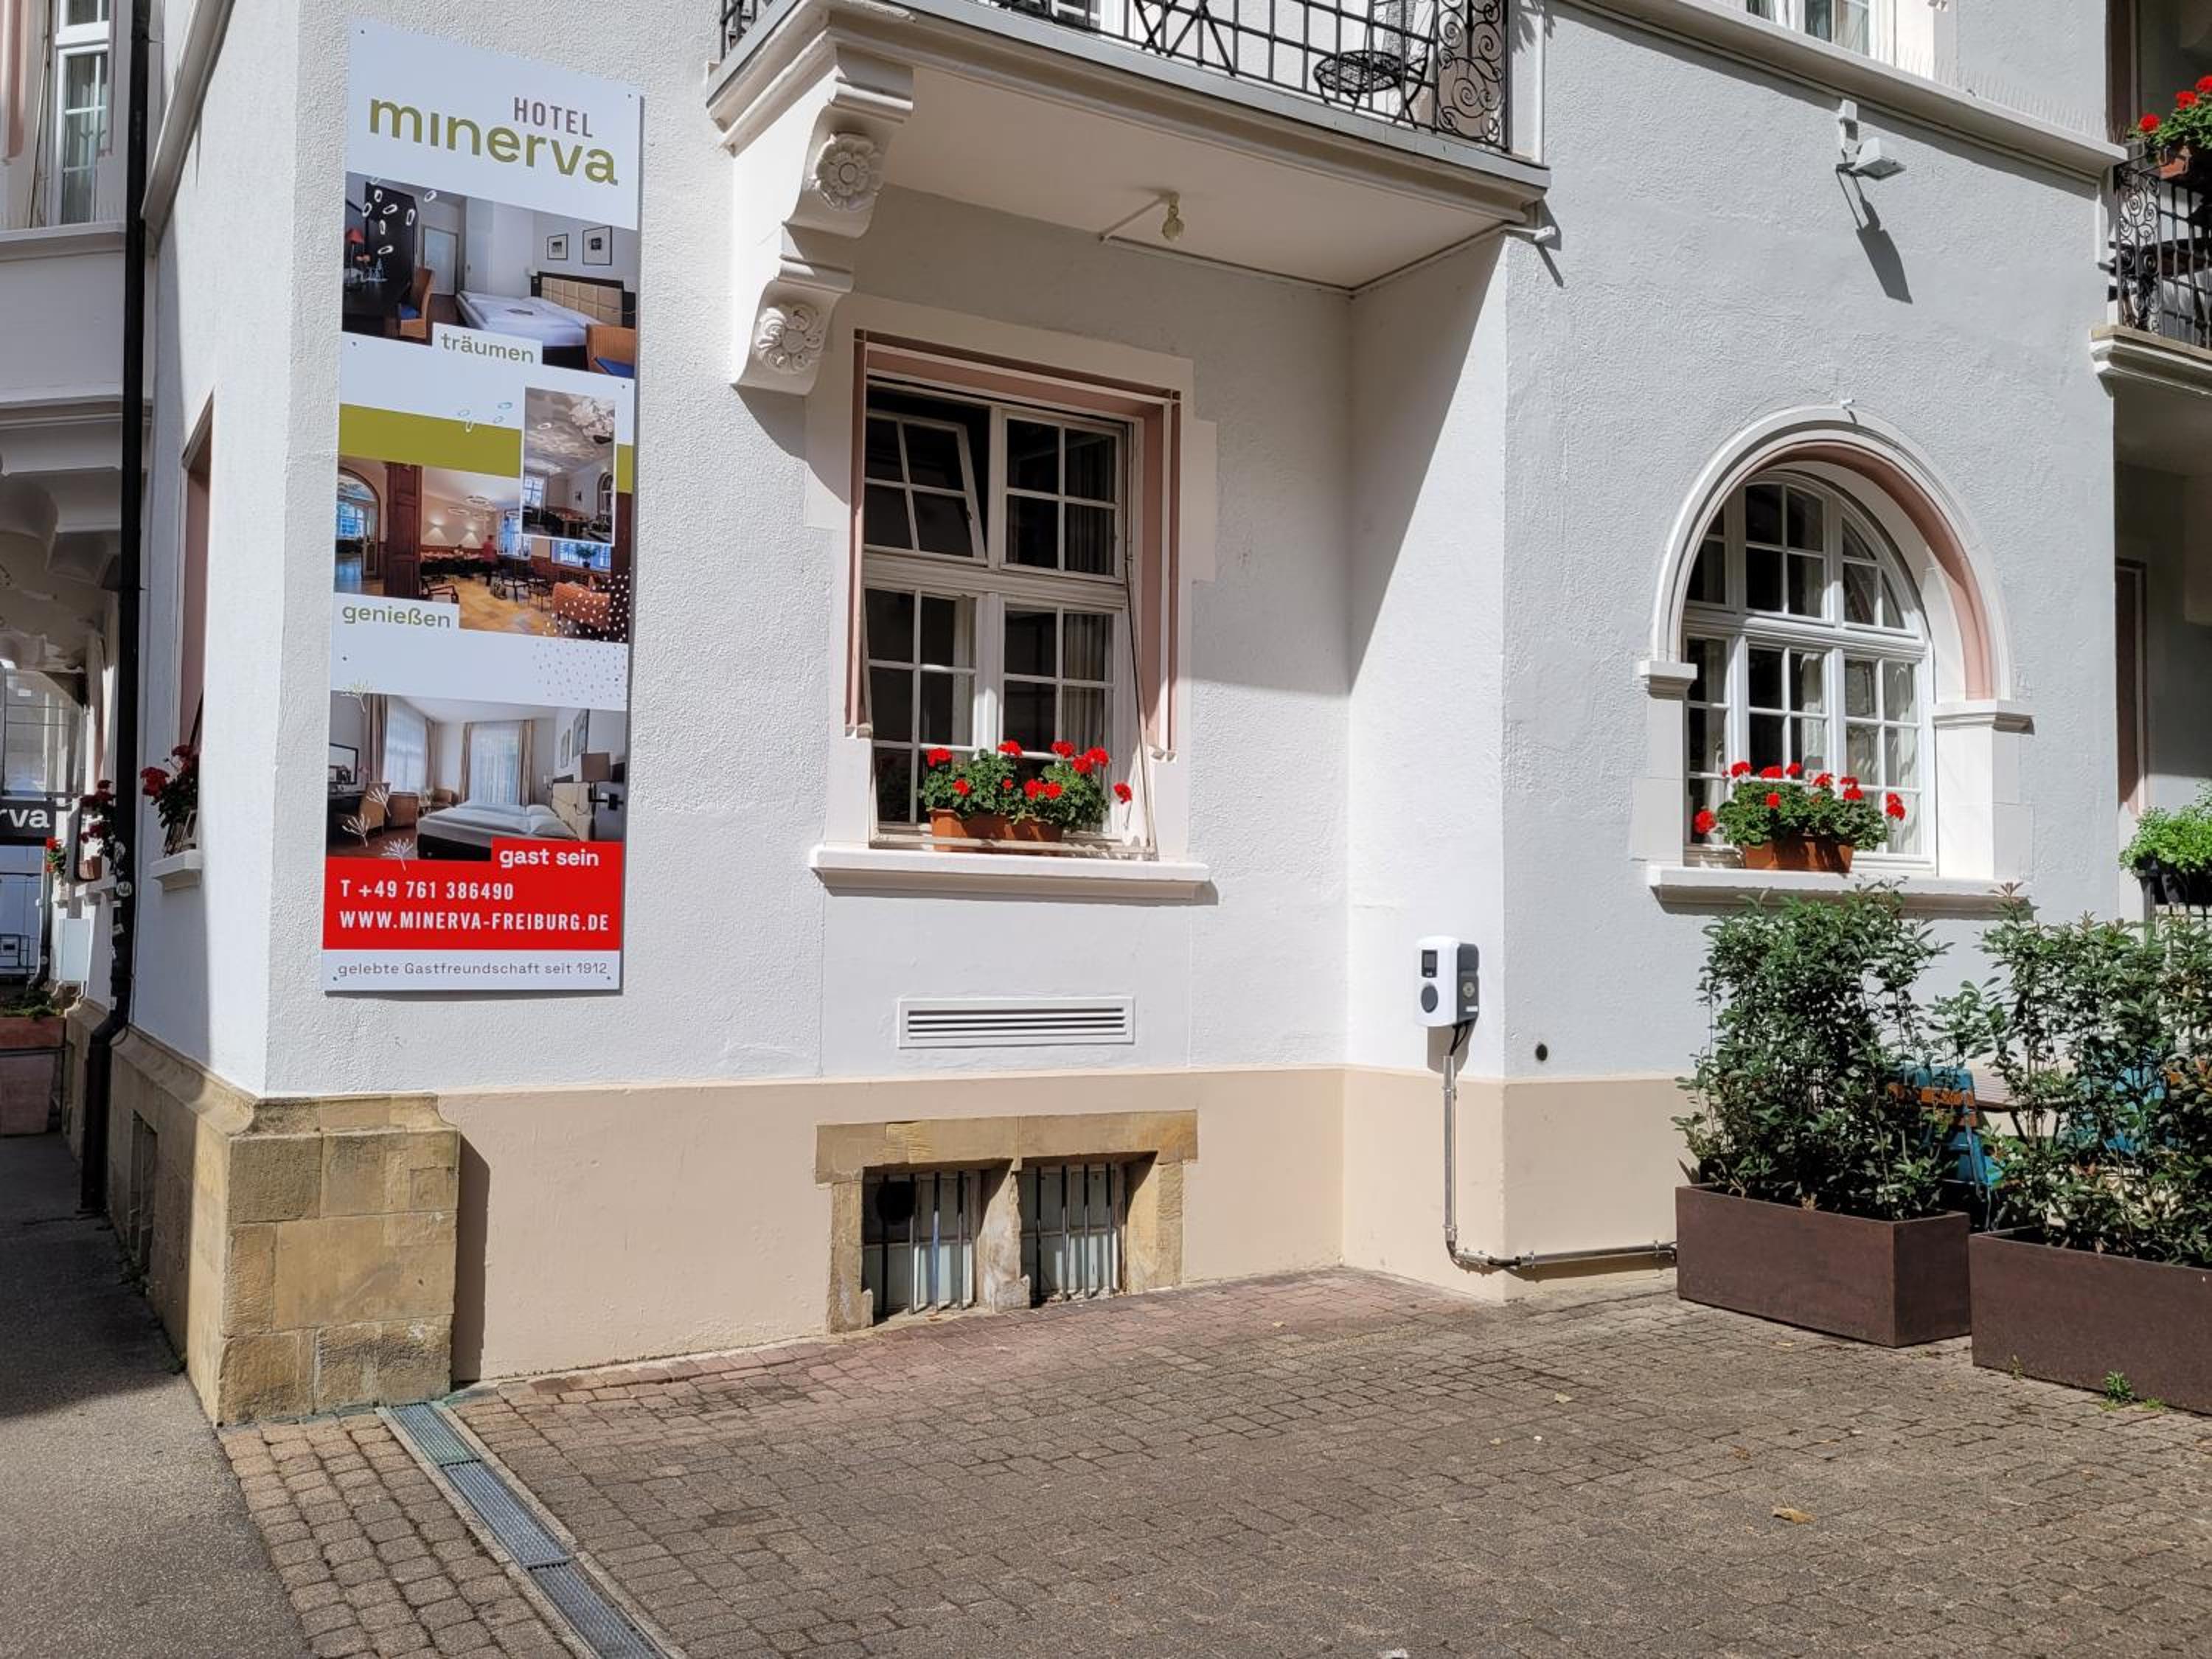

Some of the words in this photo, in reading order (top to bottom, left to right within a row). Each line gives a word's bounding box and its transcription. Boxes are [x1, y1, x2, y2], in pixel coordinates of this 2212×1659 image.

[514, 97, 593, 137] HOTEL
[369, 98, 618, 186] minerva
[441, 333, 534, 363] träumen
[342, 605, 451, 628] genießen
[499, 849, 549, 869] gast
[556, 849, 599, 866] sein
[340, 880, 351, 897] T
[358, 880, 397, 898] +49
[406, 880, 437, 899] 761
[445, 883, 515, 900] 386490
[340, 910, 609, 931] WWW.MINERVA-FREIBURG.DE
[338, 963, 400, 975] gelebte
[404, 962, 540, 975] Gastfreundschaft
[544, 962, 571, 975] seit
[577, 962, 608, 975] 1912
